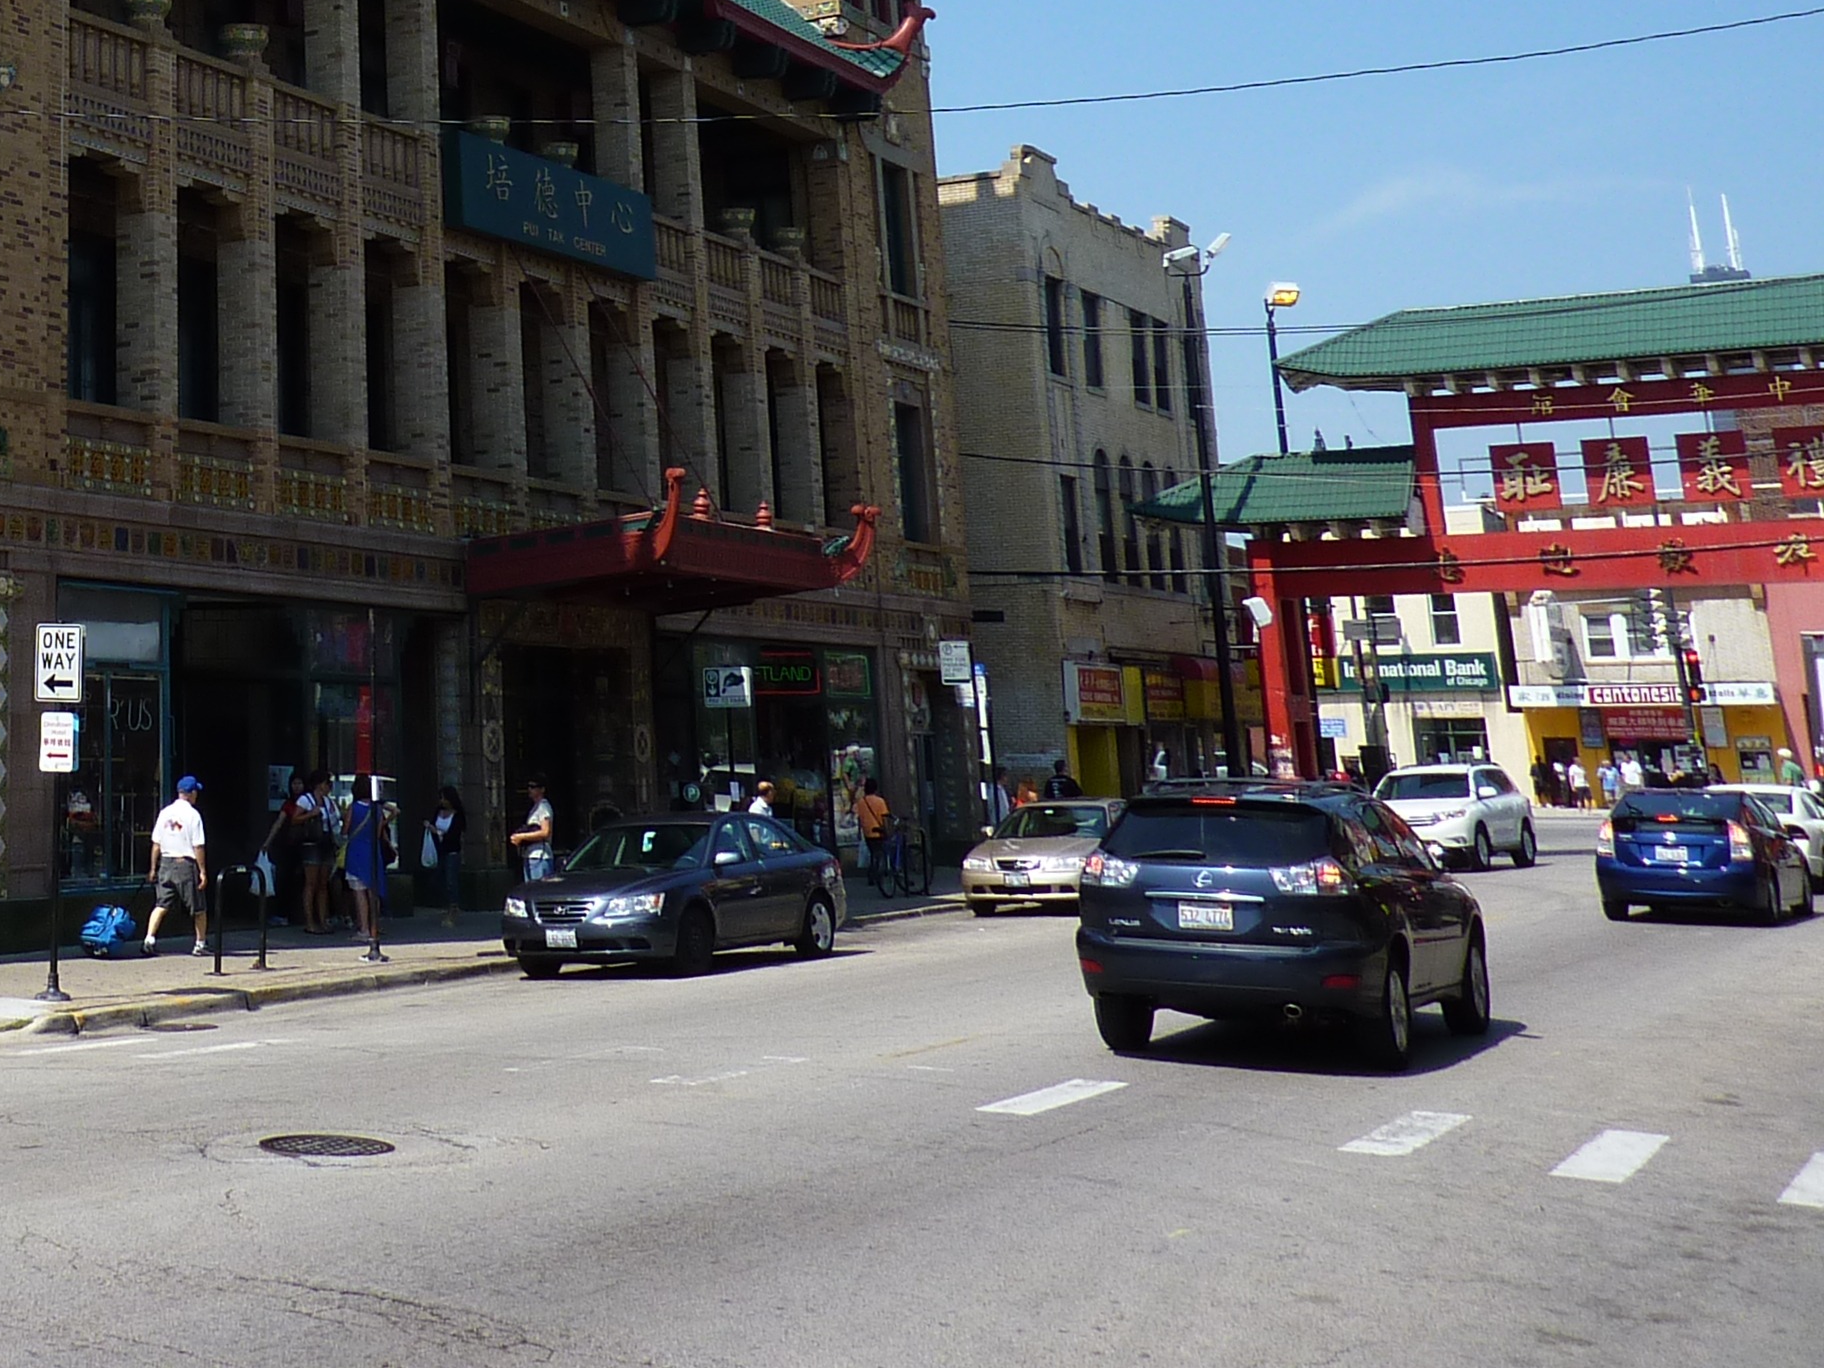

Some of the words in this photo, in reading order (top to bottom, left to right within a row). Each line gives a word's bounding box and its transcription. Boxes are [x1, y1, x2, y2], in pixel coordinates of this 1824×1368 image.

[485, 152, 634, 233] 培德中心
[523, 221, 539, 237] PUI
[547, 228, 565, 244] TAK
[573, 237, 607, 257] CENTER
[43, 632, 76, 649] ONE
[41, 652, 76, 670] WAY
[1445, 659, 1487, 676] Bank
[1446, 677, 1455, 686] of
[1456, 676, 1488, 687] Chicago
